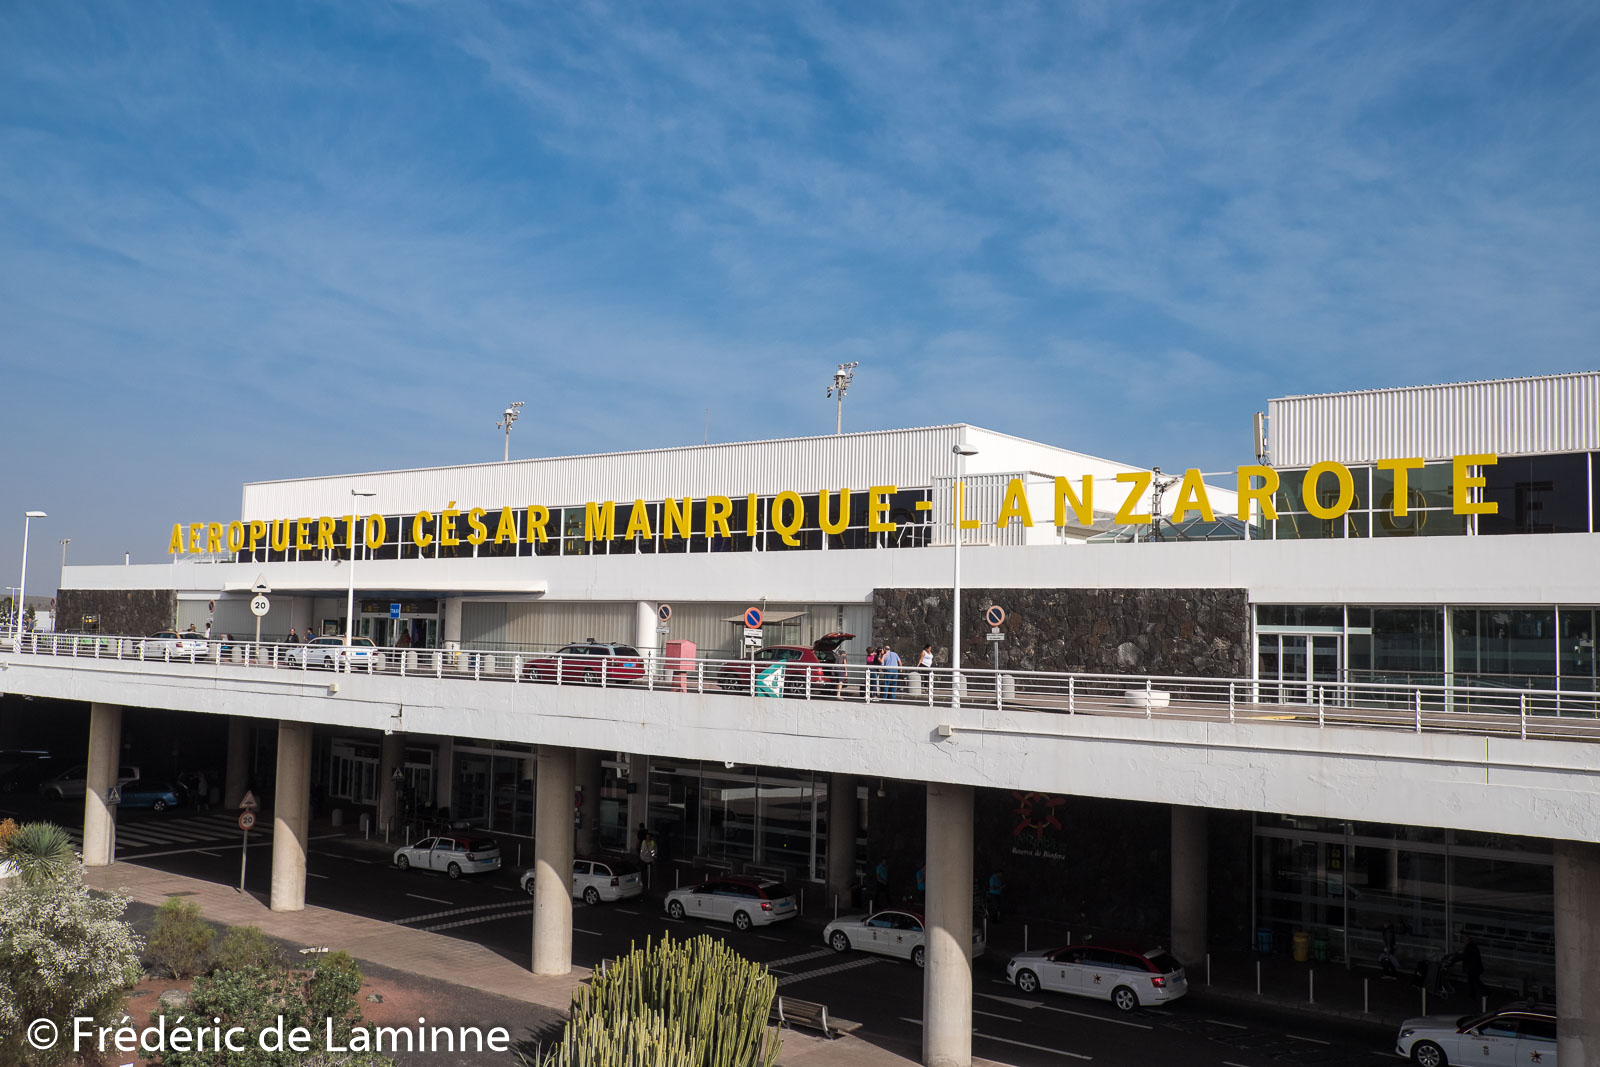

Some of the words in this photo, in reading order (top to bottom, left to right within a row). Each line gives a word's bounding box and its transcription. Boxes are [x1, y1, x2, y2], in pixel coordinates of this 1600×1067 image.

[168, 513, 387, 554] AEROPUERTO
[412, 501, 550, 548] CÉSAR
[952, 453, 1499, 530] LANZAROTE
[254, 601, 266, 610] 20
[242, 816, 253, 824] 20
